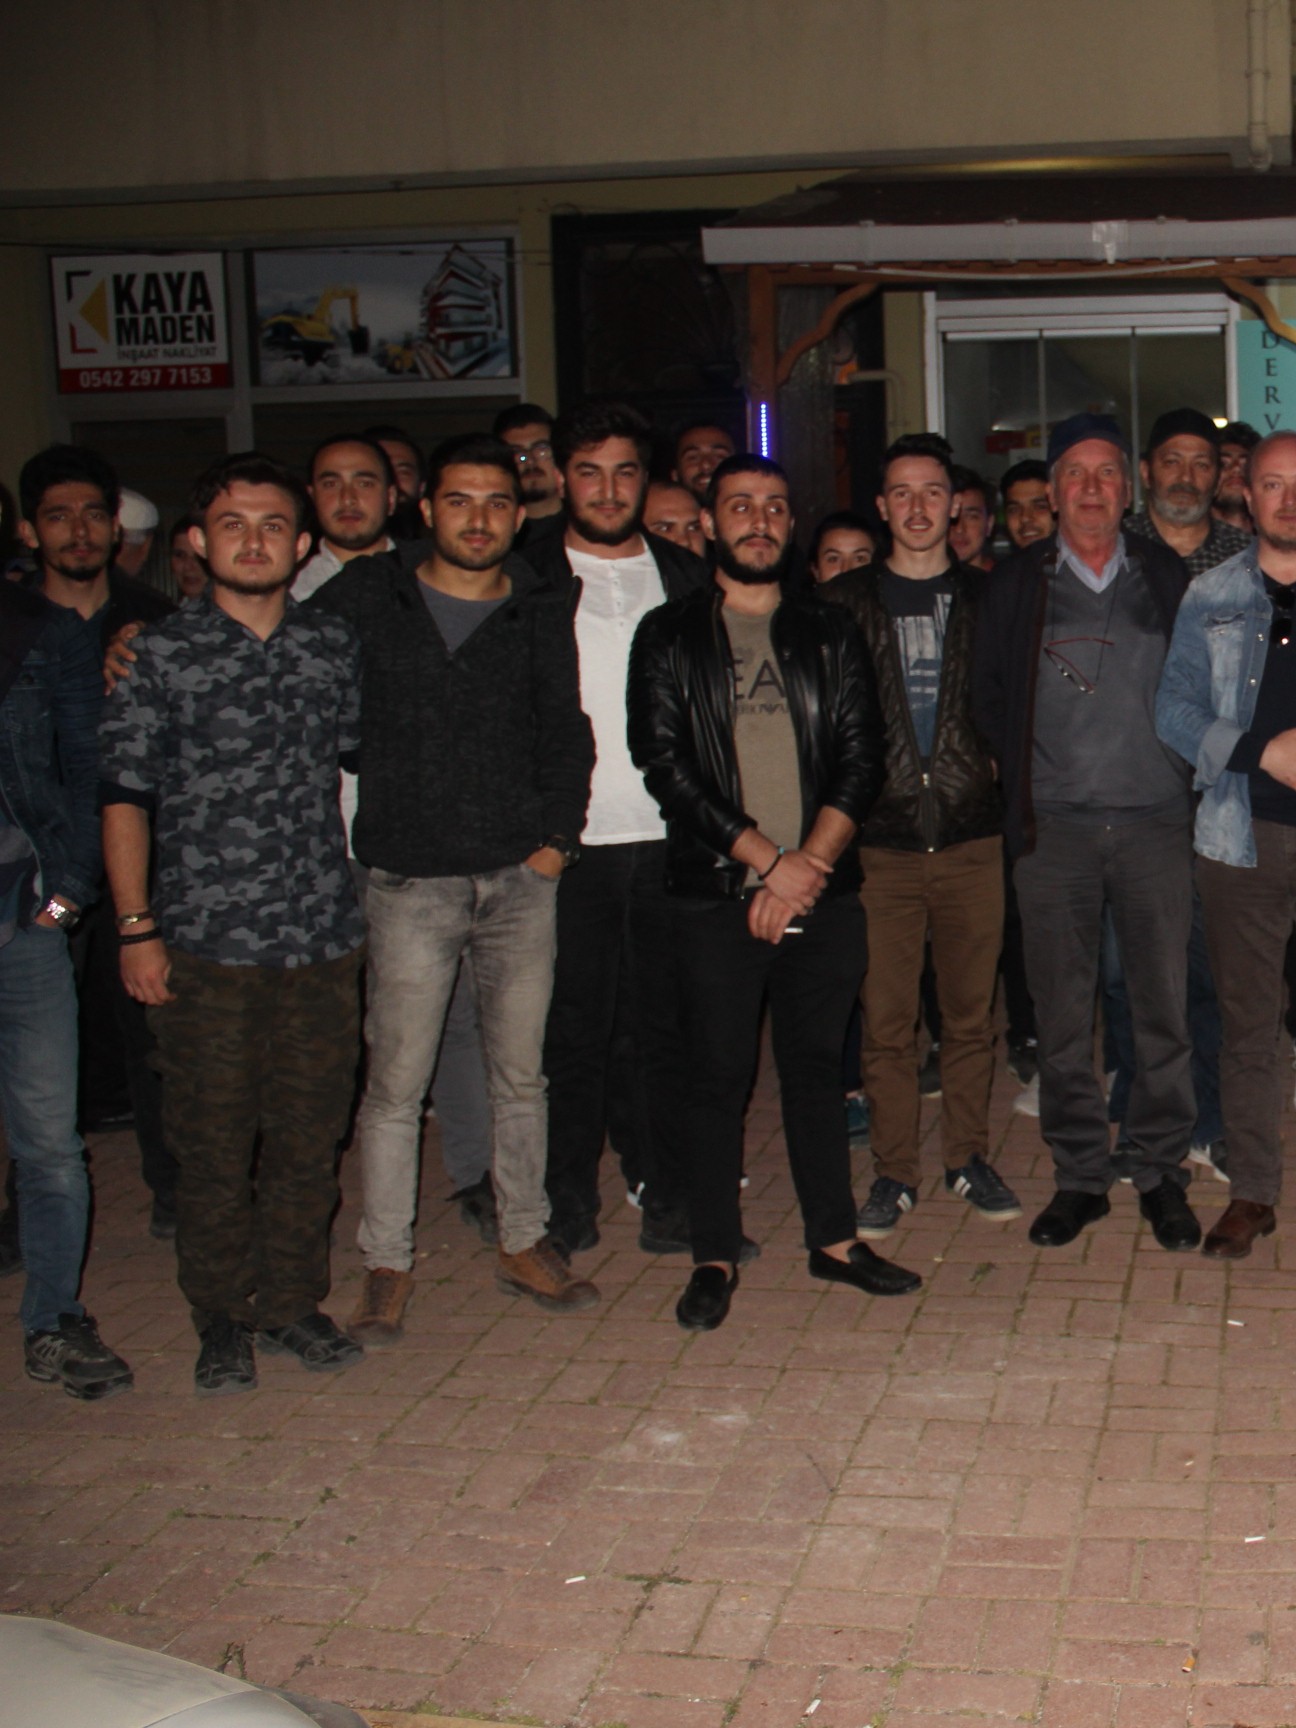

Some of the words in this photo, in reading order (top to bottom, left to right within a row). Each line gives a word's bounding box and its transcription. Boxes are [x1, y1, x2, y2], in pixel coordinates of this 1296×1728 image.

[112, 271, 214, 315] KAYA
[116, 314, 216, 345] MADEN
[79, 370, 125, 389] 0542
[129, 368, 162, 387] 297
[168, 366, 213, 385] 7153
